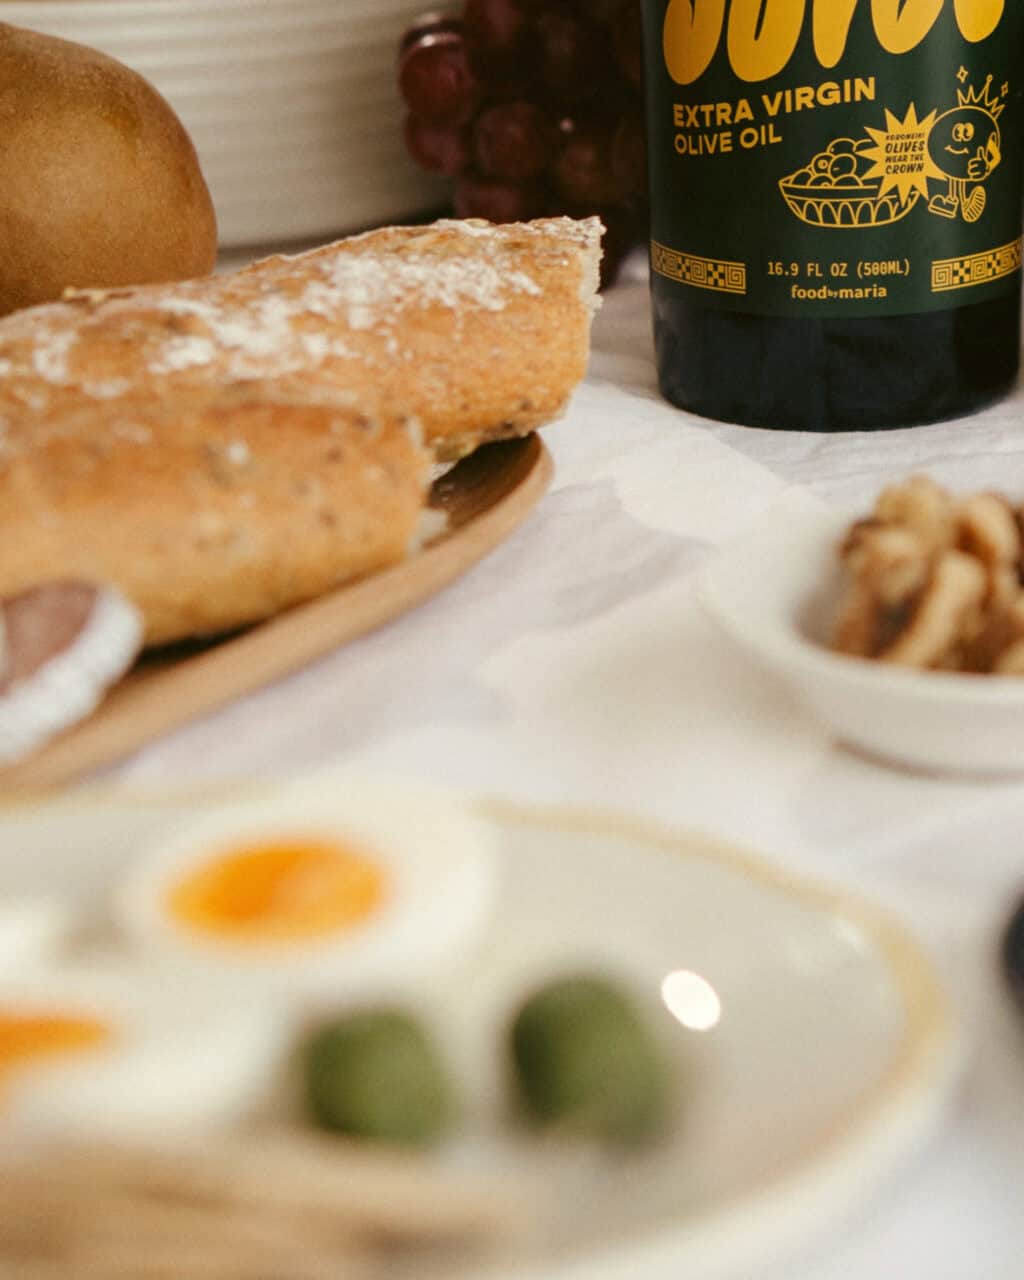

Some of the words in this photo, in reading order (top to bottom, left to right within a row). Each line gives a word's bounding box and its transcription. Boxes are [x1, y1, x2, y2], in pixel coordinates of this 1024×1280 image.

[673, 99, 755, 128] EXTRA
[761, 76, 876, 117] VIRGIN
[674, 131, 733, 156] OLIVE
[739, 123, 783, 149] OIL
[885, 140, 925, 153] OLIVES
[910, 153, 924, 162] THE
[885, 162, 925, 175] CROWN
[767, 261, 799, 276] 16.9
[807, 262, 823, 277] FL
[831, 262, 848, 277] OZ
[857, 258, 911, 279] (500ML)
